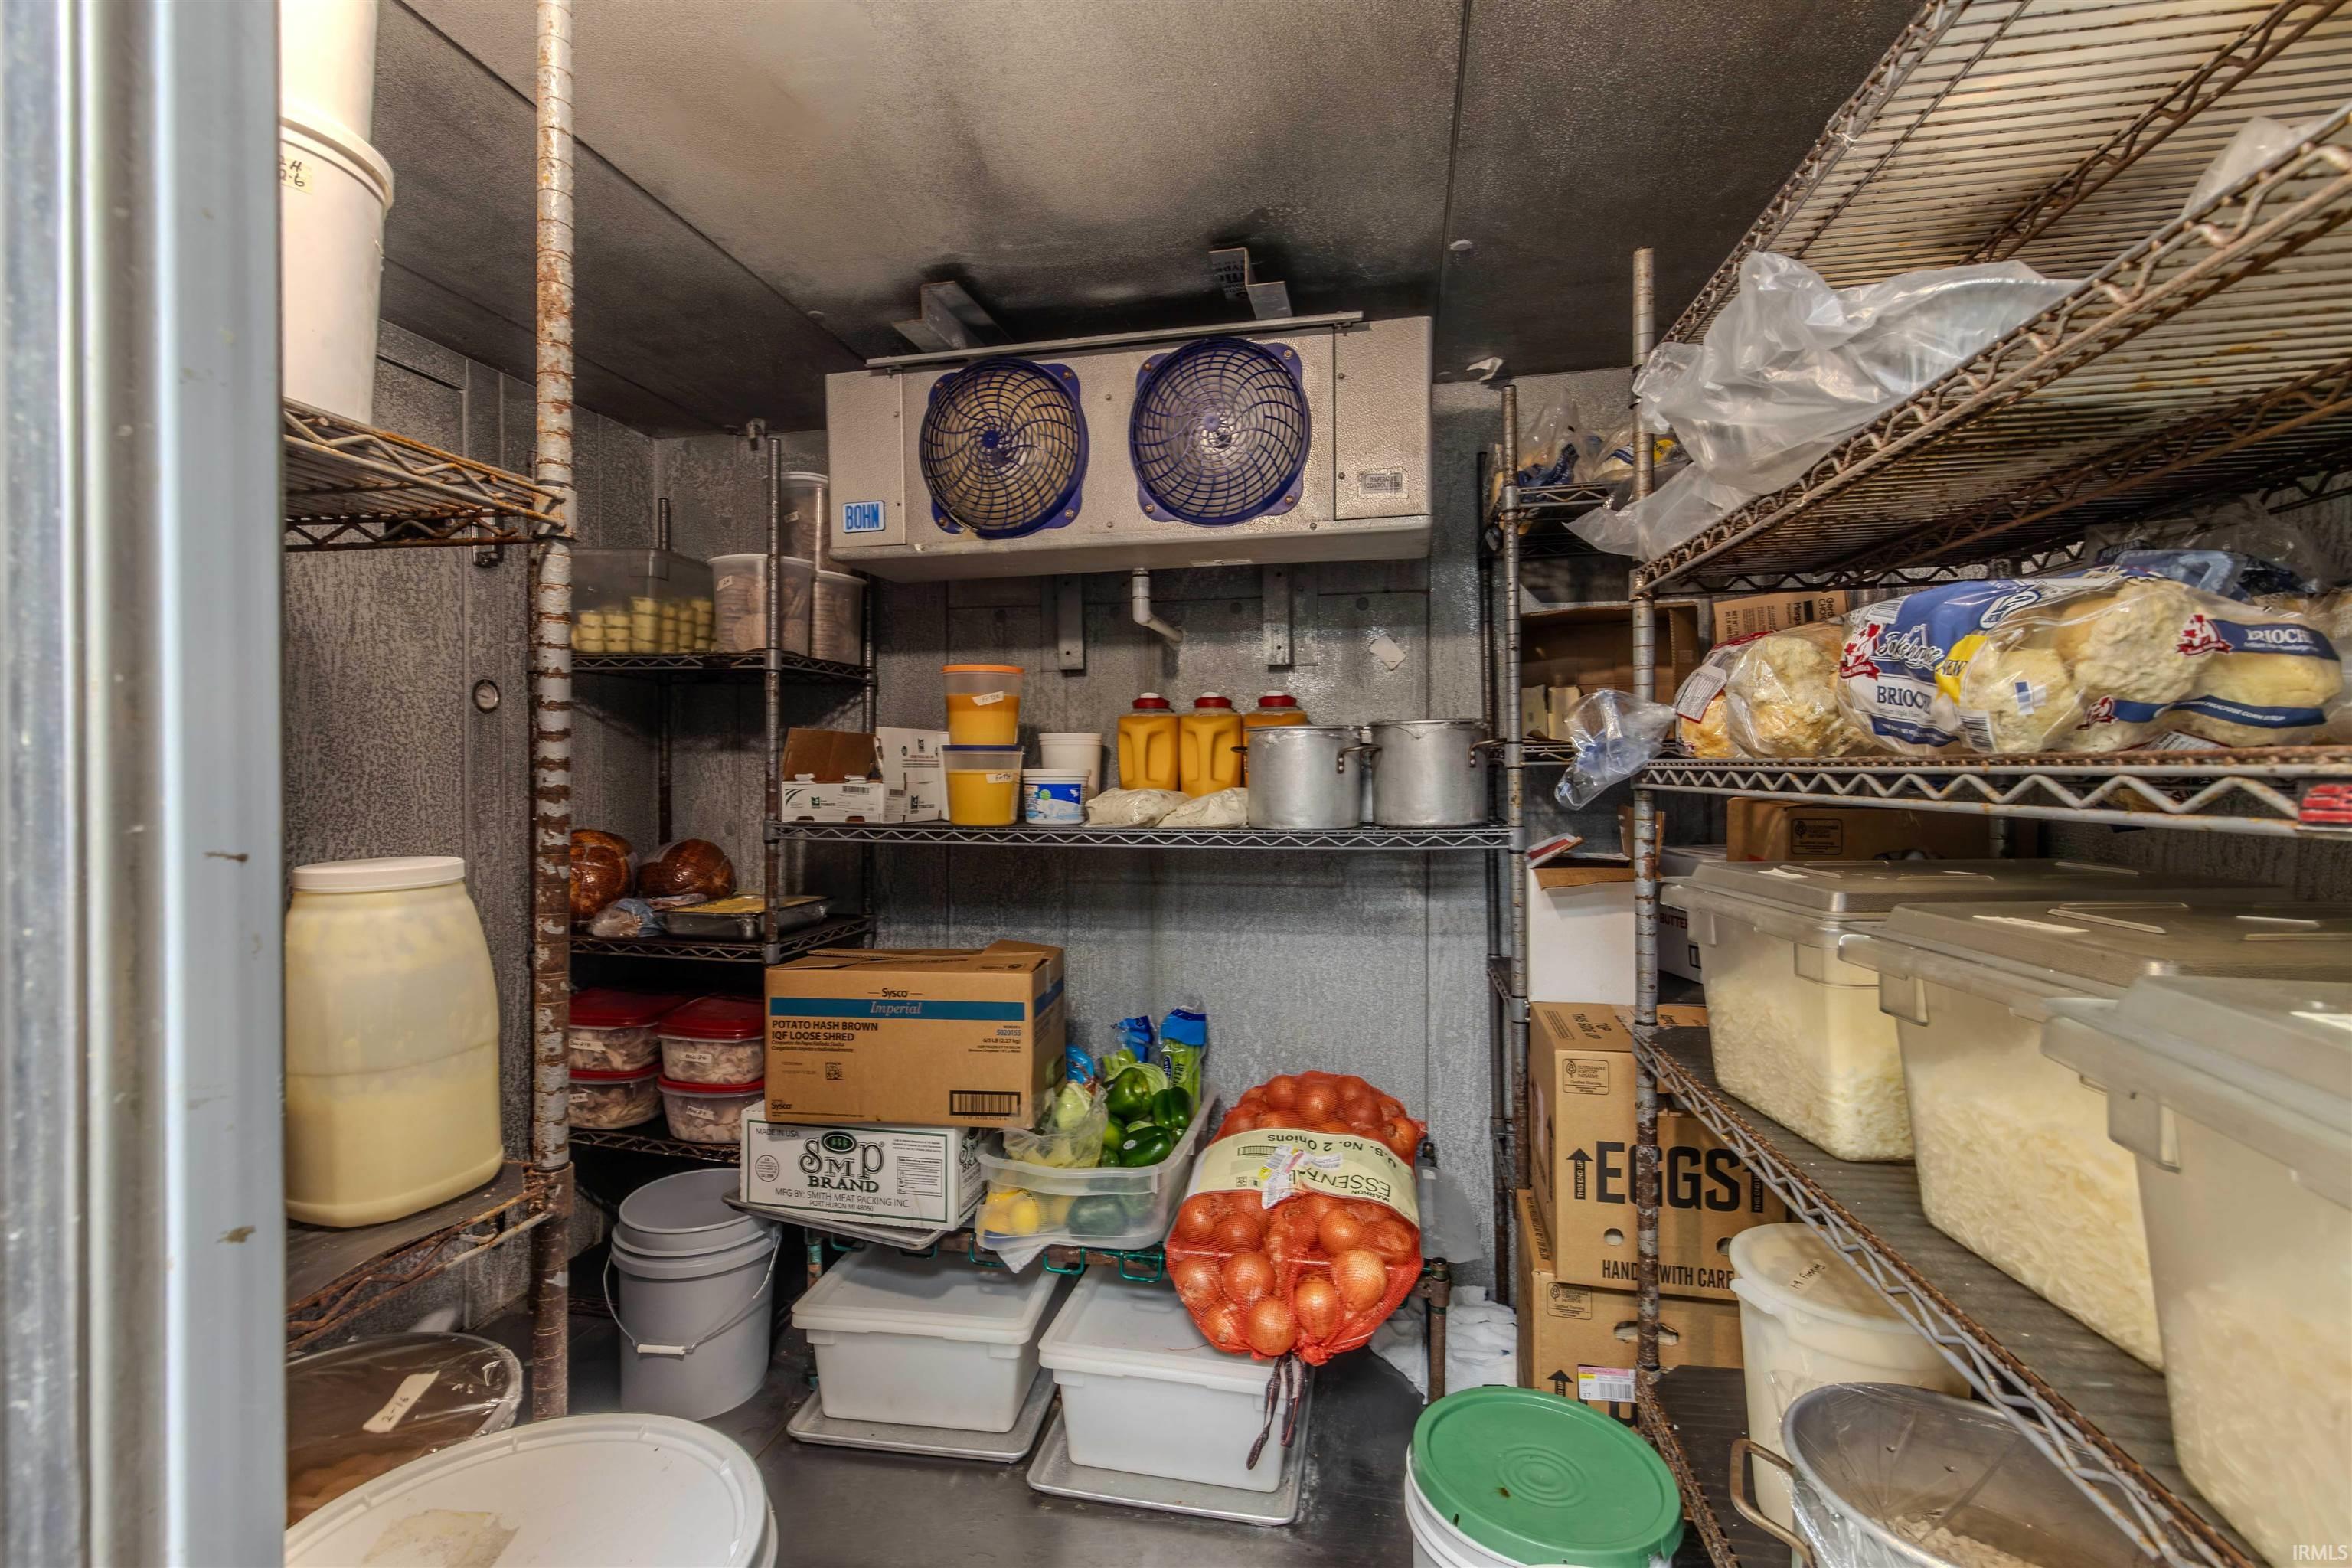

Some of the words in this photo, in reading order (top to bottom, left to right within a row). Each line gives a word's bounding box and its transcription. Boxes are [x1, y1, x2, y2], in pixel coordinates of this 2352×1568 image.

[844, 503, 880, 530] BOHN
[1818, 599, 1827, 622] CHOIC
[1826, 598, 1835, 619] Gord
[2245, 628, 2314, 645] BRIOCH
[1877, 685, 1932, 715] BRIOCH
[1660, 913, 1687, 929] BUTTE
[881, 988, 908, 998] Sysco
[870, 1001, 923, 1016] Imperial
[772, 1020, 811, 1030] POTATO
[813, 1021, 840, 1030] HASH
[841, 1022, 879, 1031] BROWN
[772, 1031, 788, 1040] IQF
[789, 1031, 822, 1040] LOOSE
[824, 1032, 855, 1042] SHRED
[771, 1102, 792, 1110] Sysco
[756, 1127, 773, 1136] MADE
[775, 1129, 784, 1137] IN
[785, 1129, 800, 1138] USA
[1267, 1134, 1318, 1150] Onions
[1323, 1142, 1333, 1152] 2
[1339, 1141, 1363, 1151] No.
[1370, 1145, 1397, 1168] U.S.
[1576, 1160, 1584, 1169] UP
[808, 1175, 880, 1193] BRAND
[774, 1187, 792, 1197] MFG
[793, 1189, 805, 1198] BY:
[807, 1191, 832, 1201] SMITH
[834, 1193, 855, 1203] MEAT
[857, 1194, 892, 1207] PACKING
[1351, 1189, 1390, 1203] MARKON
[809, 1199, 825, 1207] PORT
[826, 1201, 848, 1210] HURON
[1602, 1259, 1638, 1282] HAND
[1658, 1264, 1694, 1286] WITH
